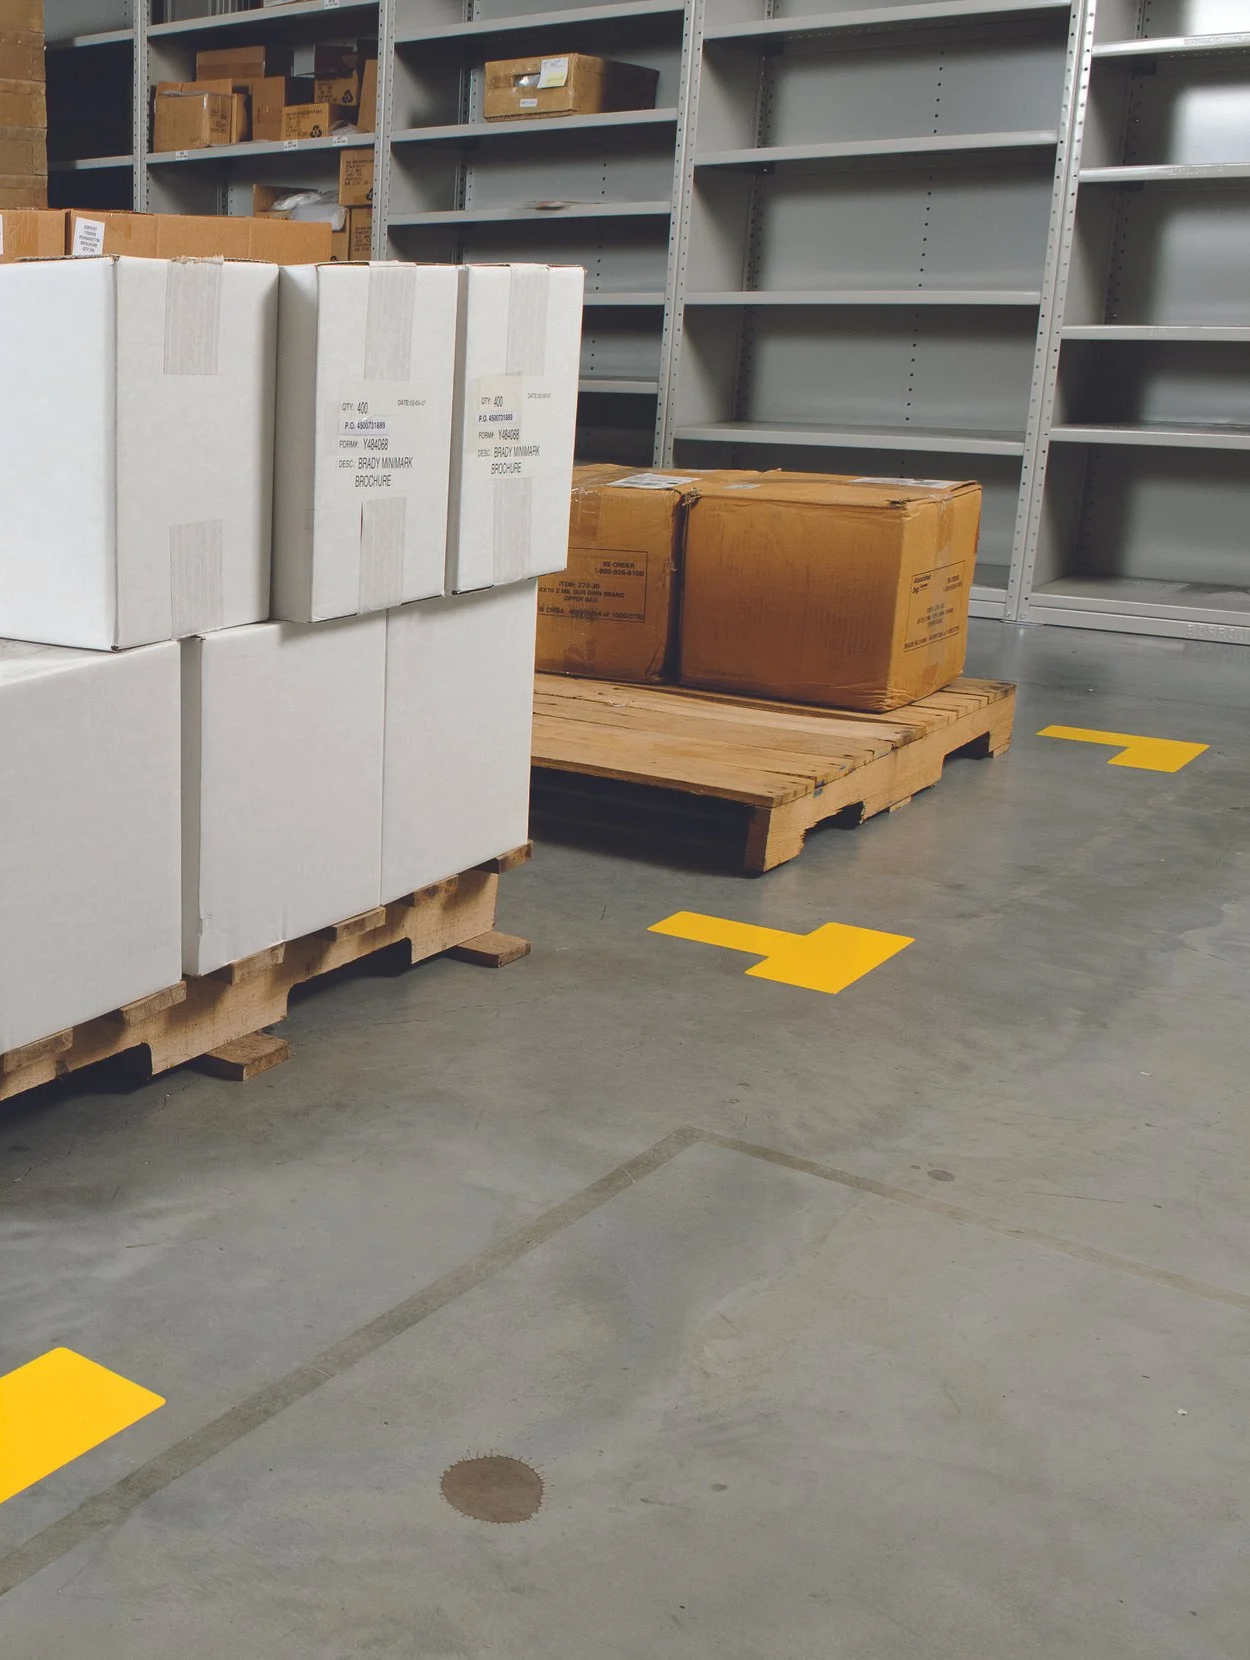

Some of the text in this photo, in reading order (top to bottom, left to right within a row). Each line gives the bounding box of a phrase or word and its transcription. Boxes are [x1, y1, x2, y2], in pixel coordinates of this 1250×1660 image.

[494, 396, 503, 407] 400
[357, 402, 368, 414] 400
[499, 429, 520, 440] Y484068
[363, 438, 389, 450] Y484068
[494, 447, 512, 458] BRADY
[514, 445, 540, 457] MINIMARK
[358, 457, 381, 469] BRADY
[382, 456, 413, 469] MINIMARK
[491, 462, 522, 474] BROCHURE
[355, 474, 391, 488] BROCHURE
